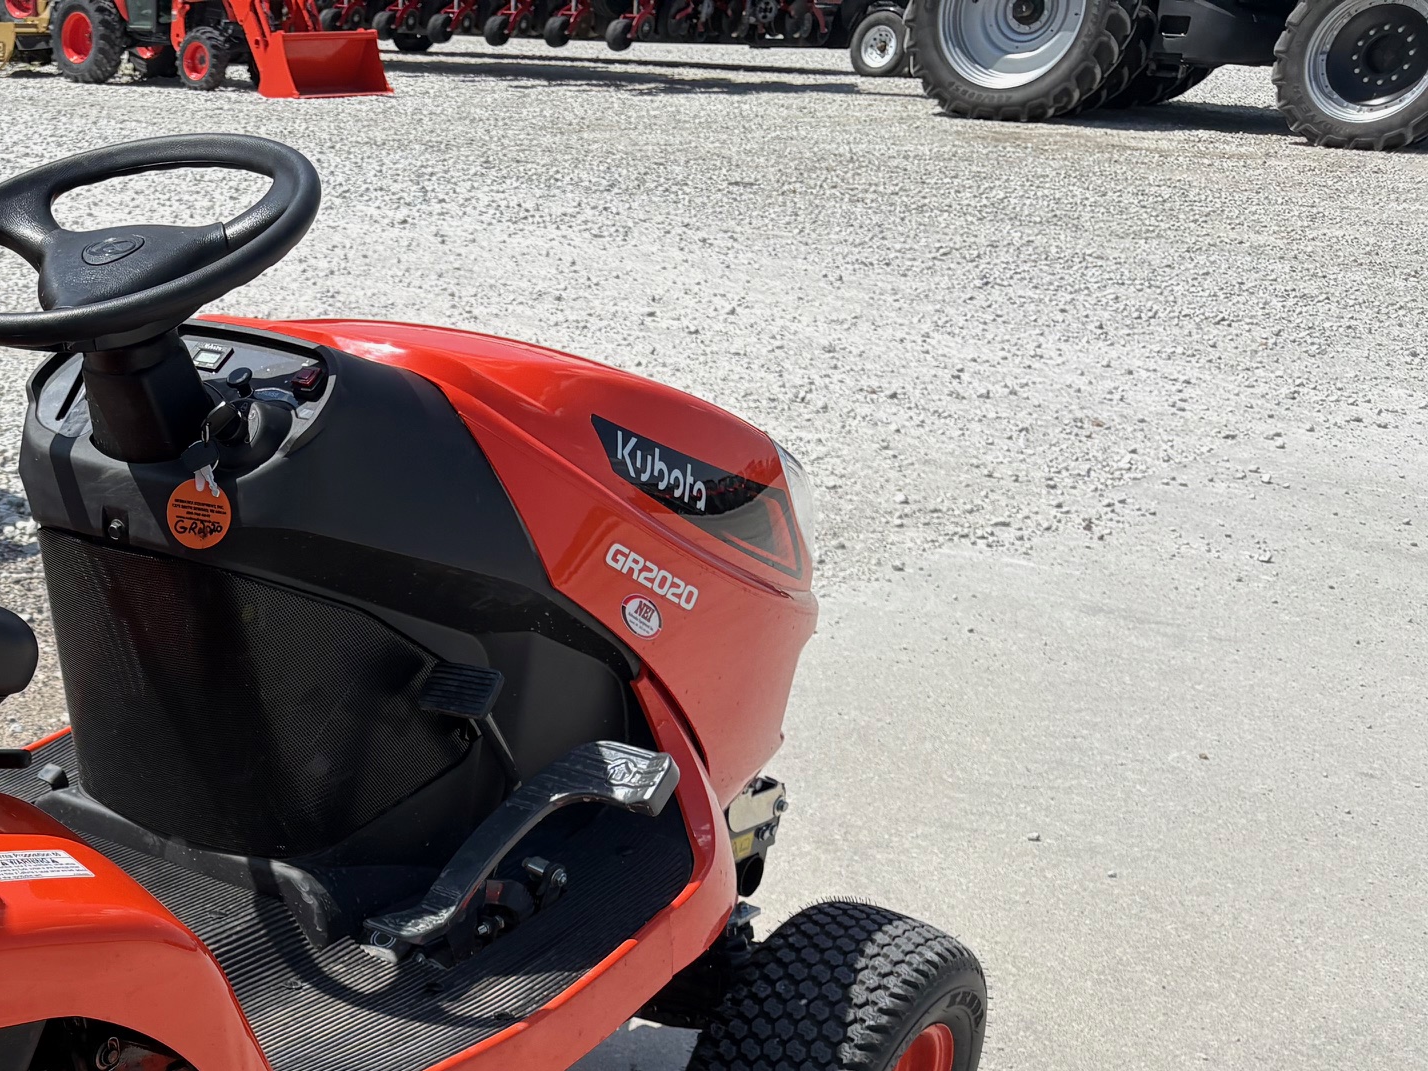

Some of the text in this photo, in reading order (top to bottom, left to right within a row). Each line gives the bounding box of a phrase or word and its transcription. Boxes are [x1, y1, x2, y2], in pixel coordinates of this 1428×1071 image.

[617, 430, 707, 511] Kubota
[605, 543, 699, 611] GR2020
[634, 600, 655, 623] NEI
